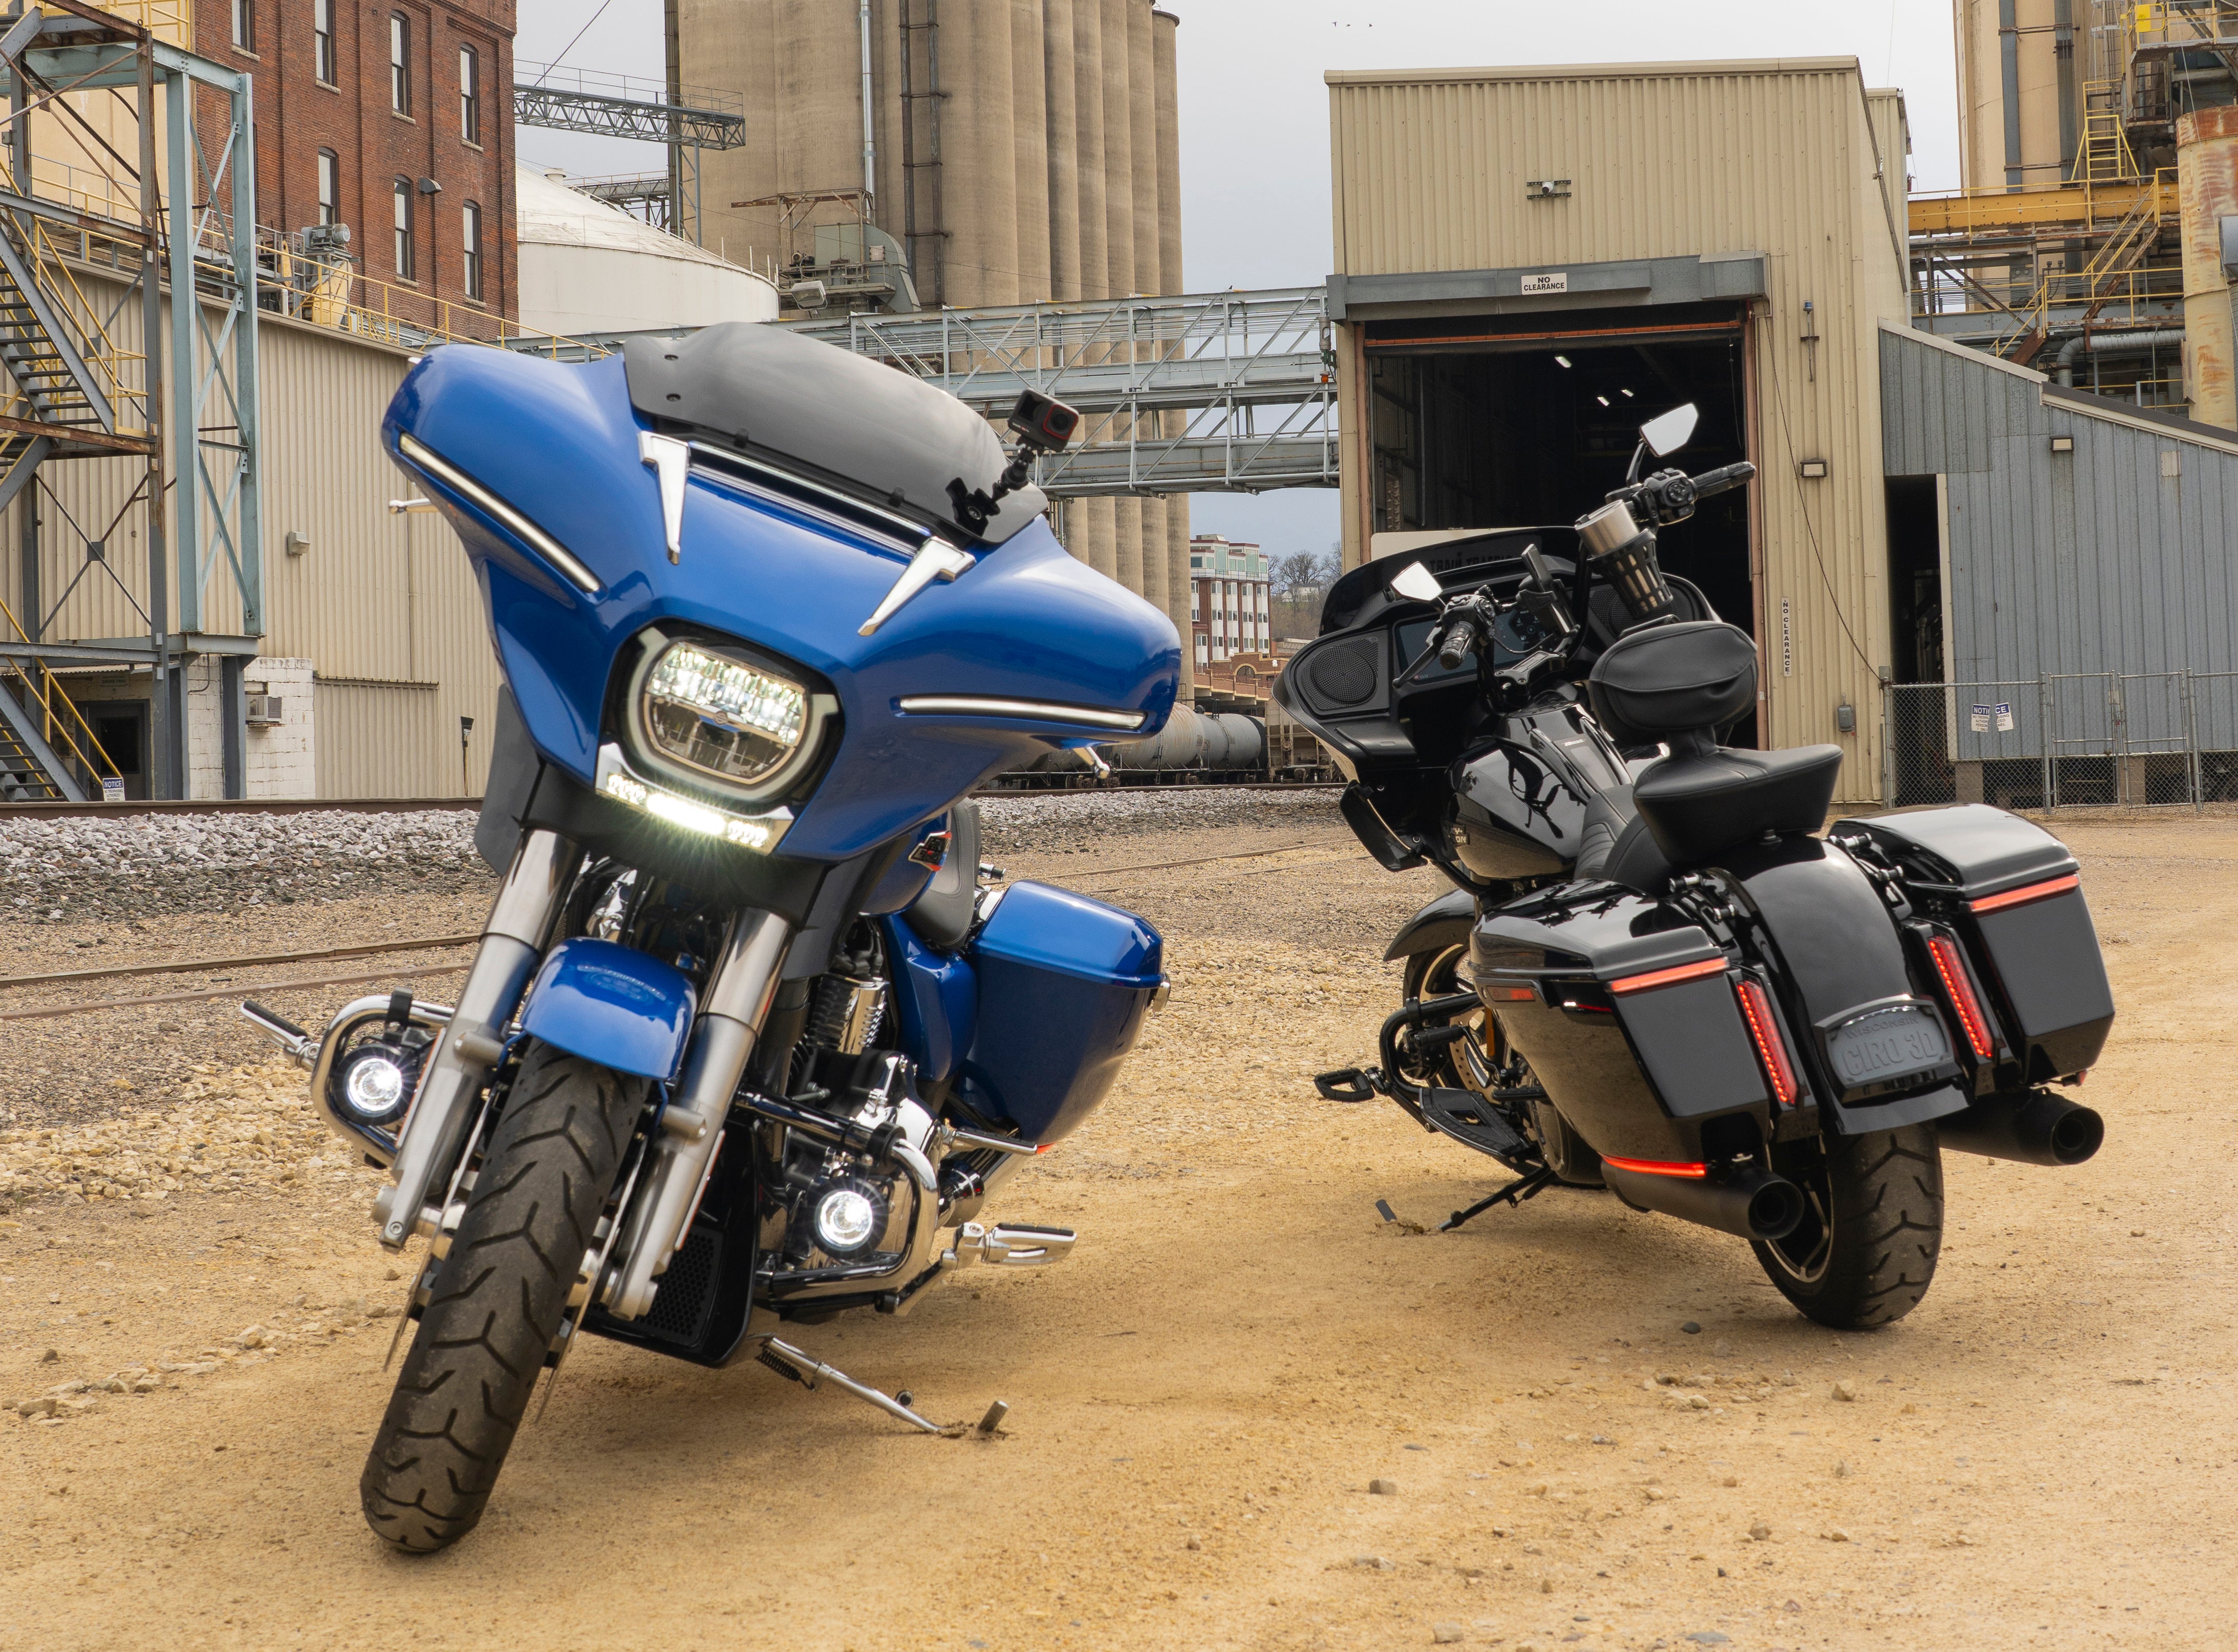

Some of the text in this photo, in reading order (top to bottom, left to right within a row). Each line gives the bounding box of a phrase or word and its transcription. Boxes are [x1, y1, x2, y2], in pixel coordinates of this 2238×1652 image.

[1524, 282, 1564, 291] CLEARANCE
[1783, 602, 1789, 614] NO
[1845, 1016, 1919, 1039] WISCONSIN
[1843, 1030, 1938, 1076] CIRO 3D
